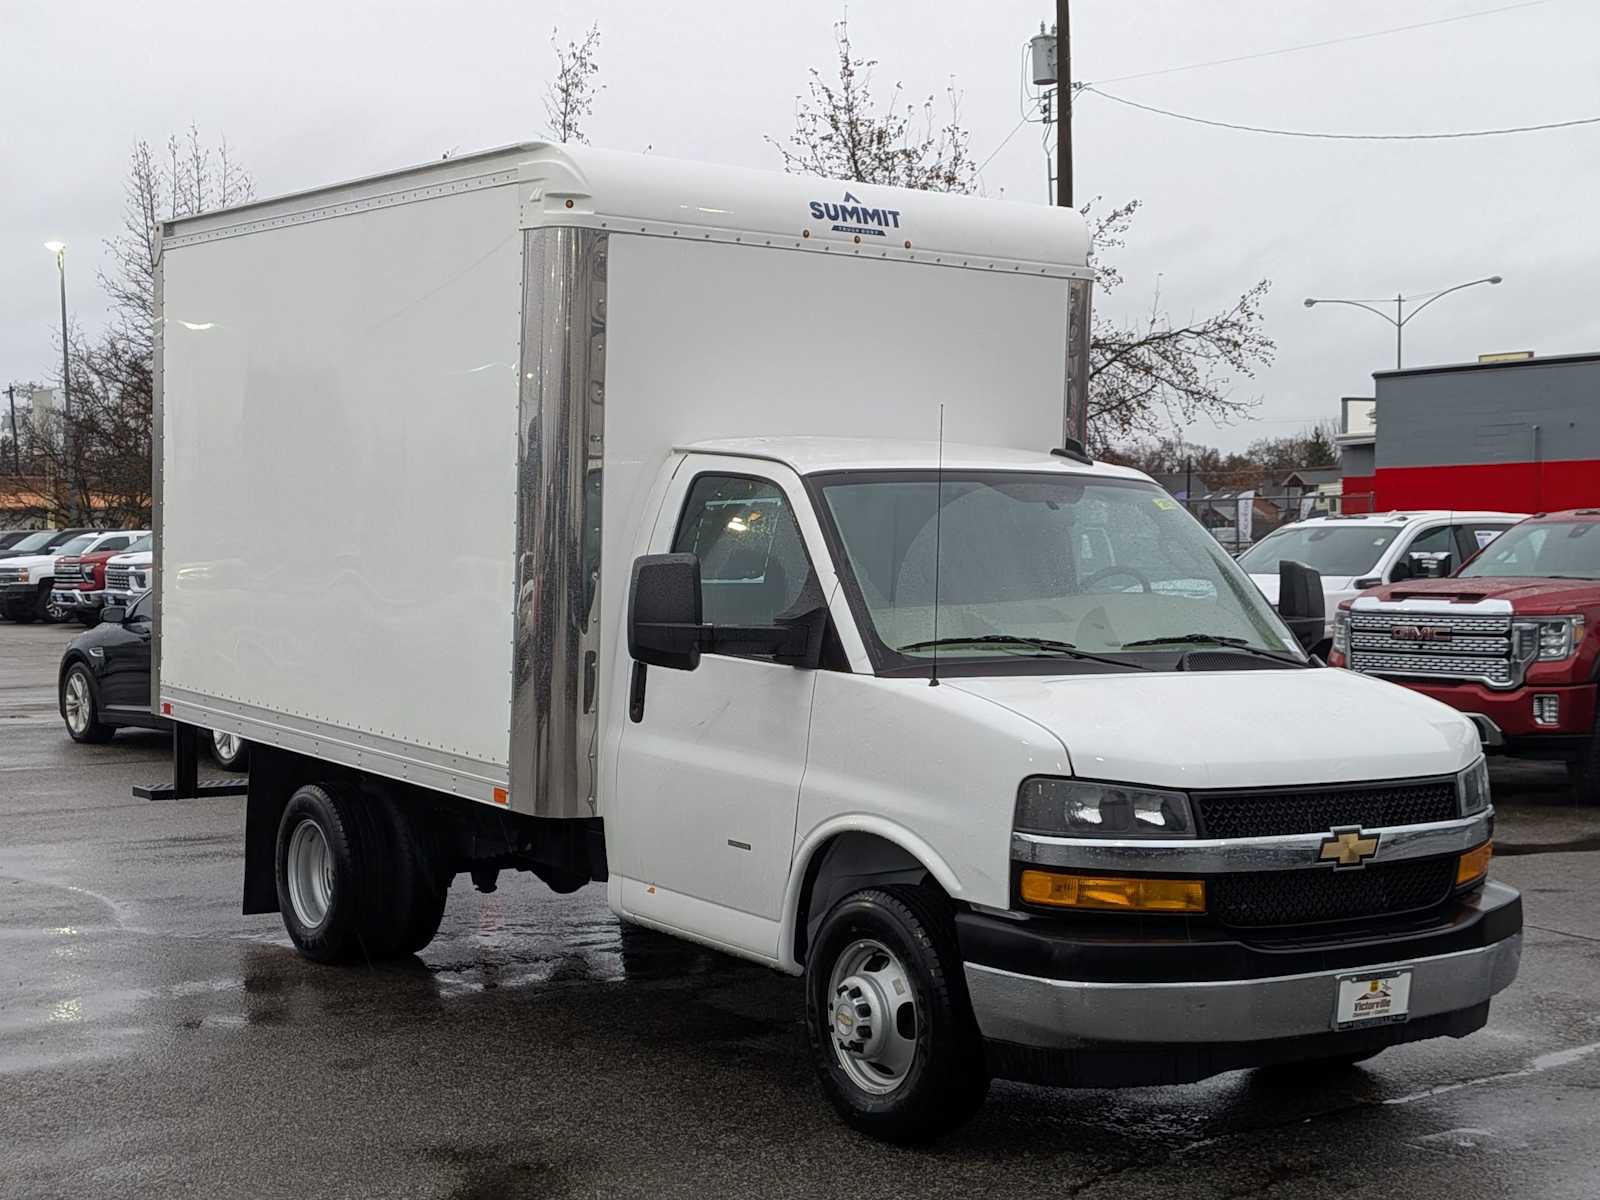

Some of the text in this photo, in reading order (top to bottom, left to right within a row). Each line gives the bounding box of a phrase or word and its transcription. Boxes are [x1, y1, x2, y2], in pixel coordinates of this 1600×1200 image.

[809, 201, 900, 228] SUMMIT
[1391, 626, 1451, 640] GMC
[1354, 999, 1391, 1012] Victorville
